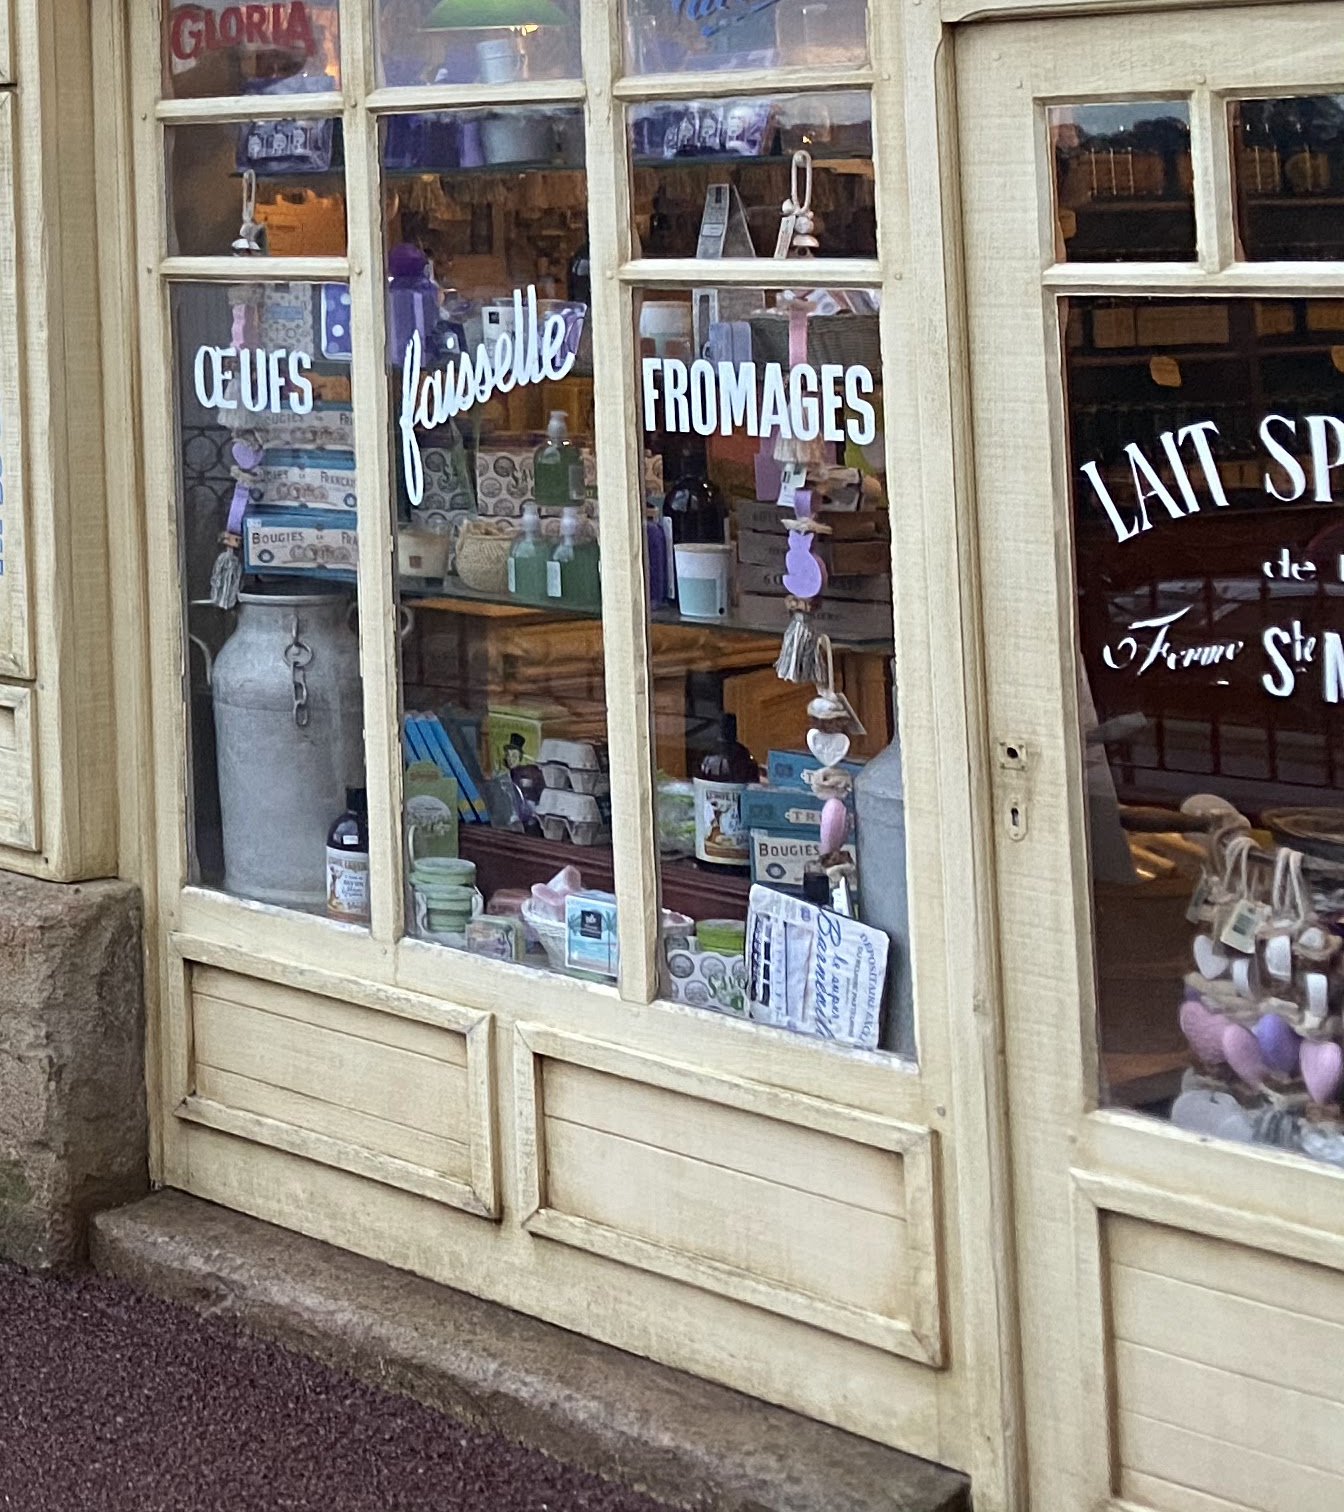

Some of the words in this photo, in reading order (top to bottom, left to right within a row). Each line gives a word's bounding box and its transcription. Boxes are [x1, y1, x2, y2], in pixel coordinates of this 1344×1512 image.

[171, 0, 317, 60] GLORIA
[399, 283, 578, 506] faisselle
[642, 356, 875, 445] FROMAGES
[1079, 420, 1230, 543] LAIT
[1258, 414, 1344, 503] SP
[1261, 548, 1317, 581] de
